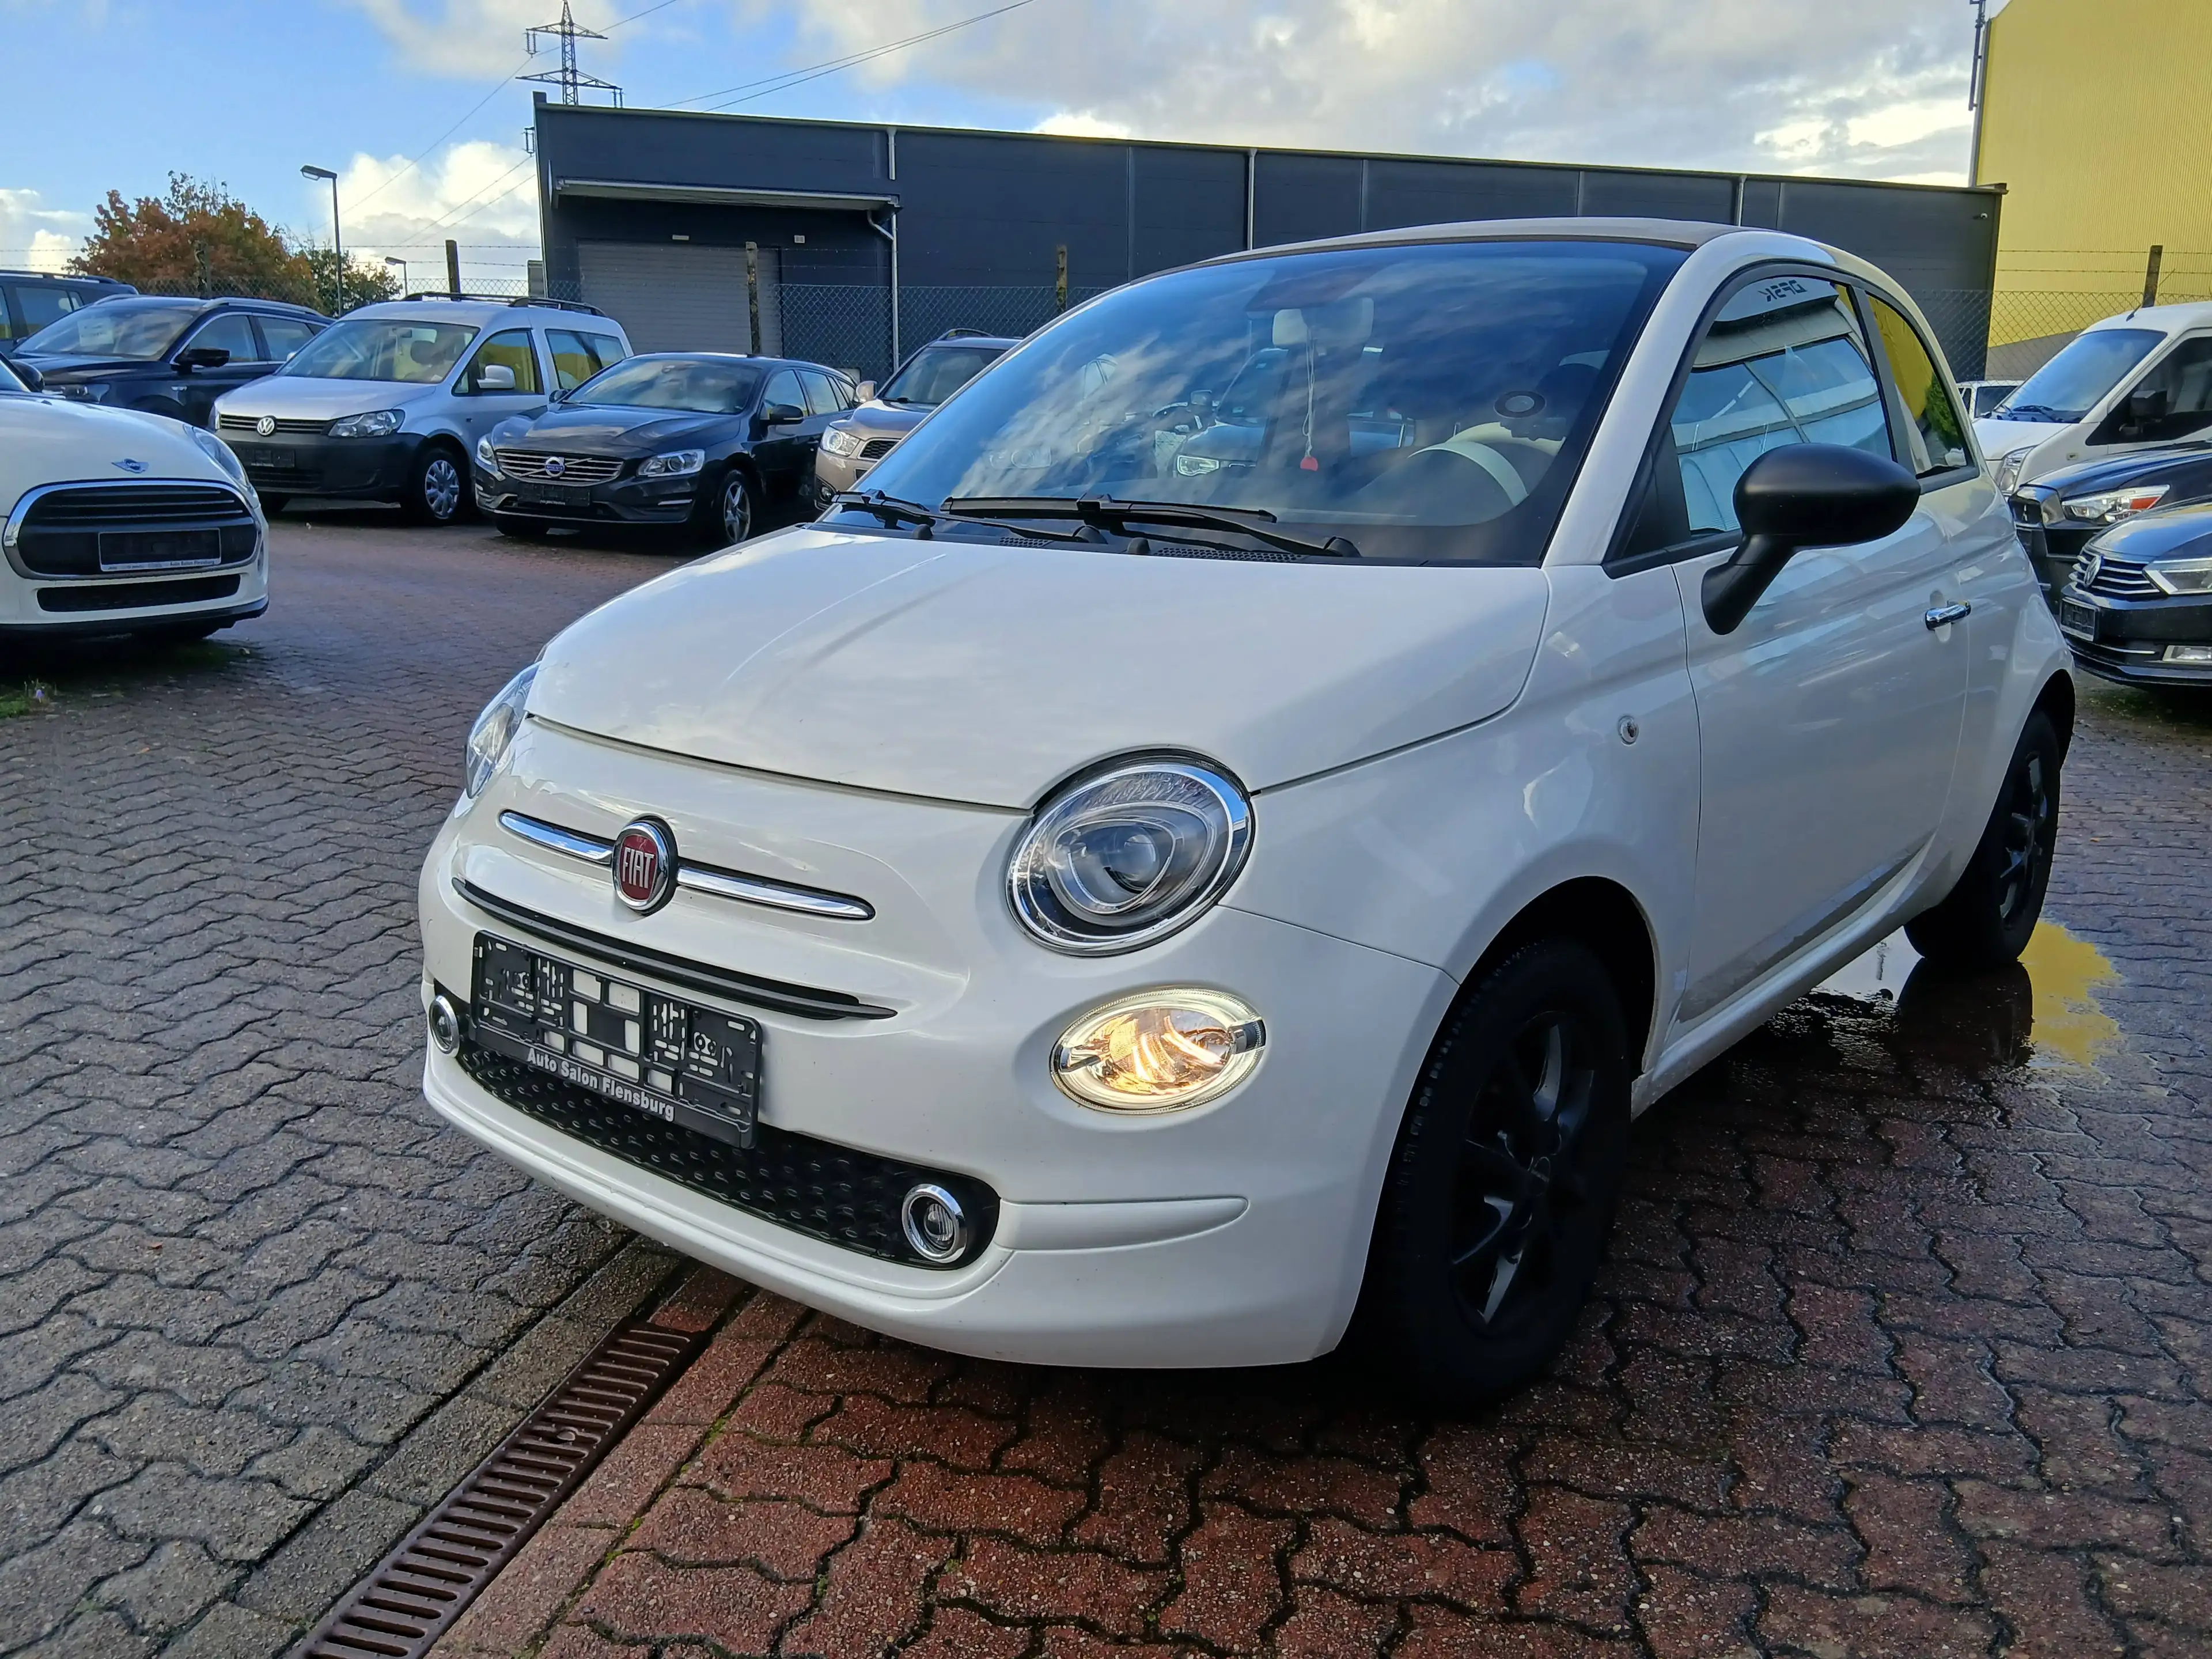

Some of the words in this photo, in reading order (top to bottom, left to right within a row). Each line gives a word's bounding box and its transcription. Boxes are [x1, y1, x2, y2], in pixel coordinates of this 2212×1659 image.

[622, 846, 655, 889] FIAT
[527, 1047, 558, 1073] Auto
[560, 1060, 599, 1089] Salon
[602, 1076, 675, 1122] Flensburg
